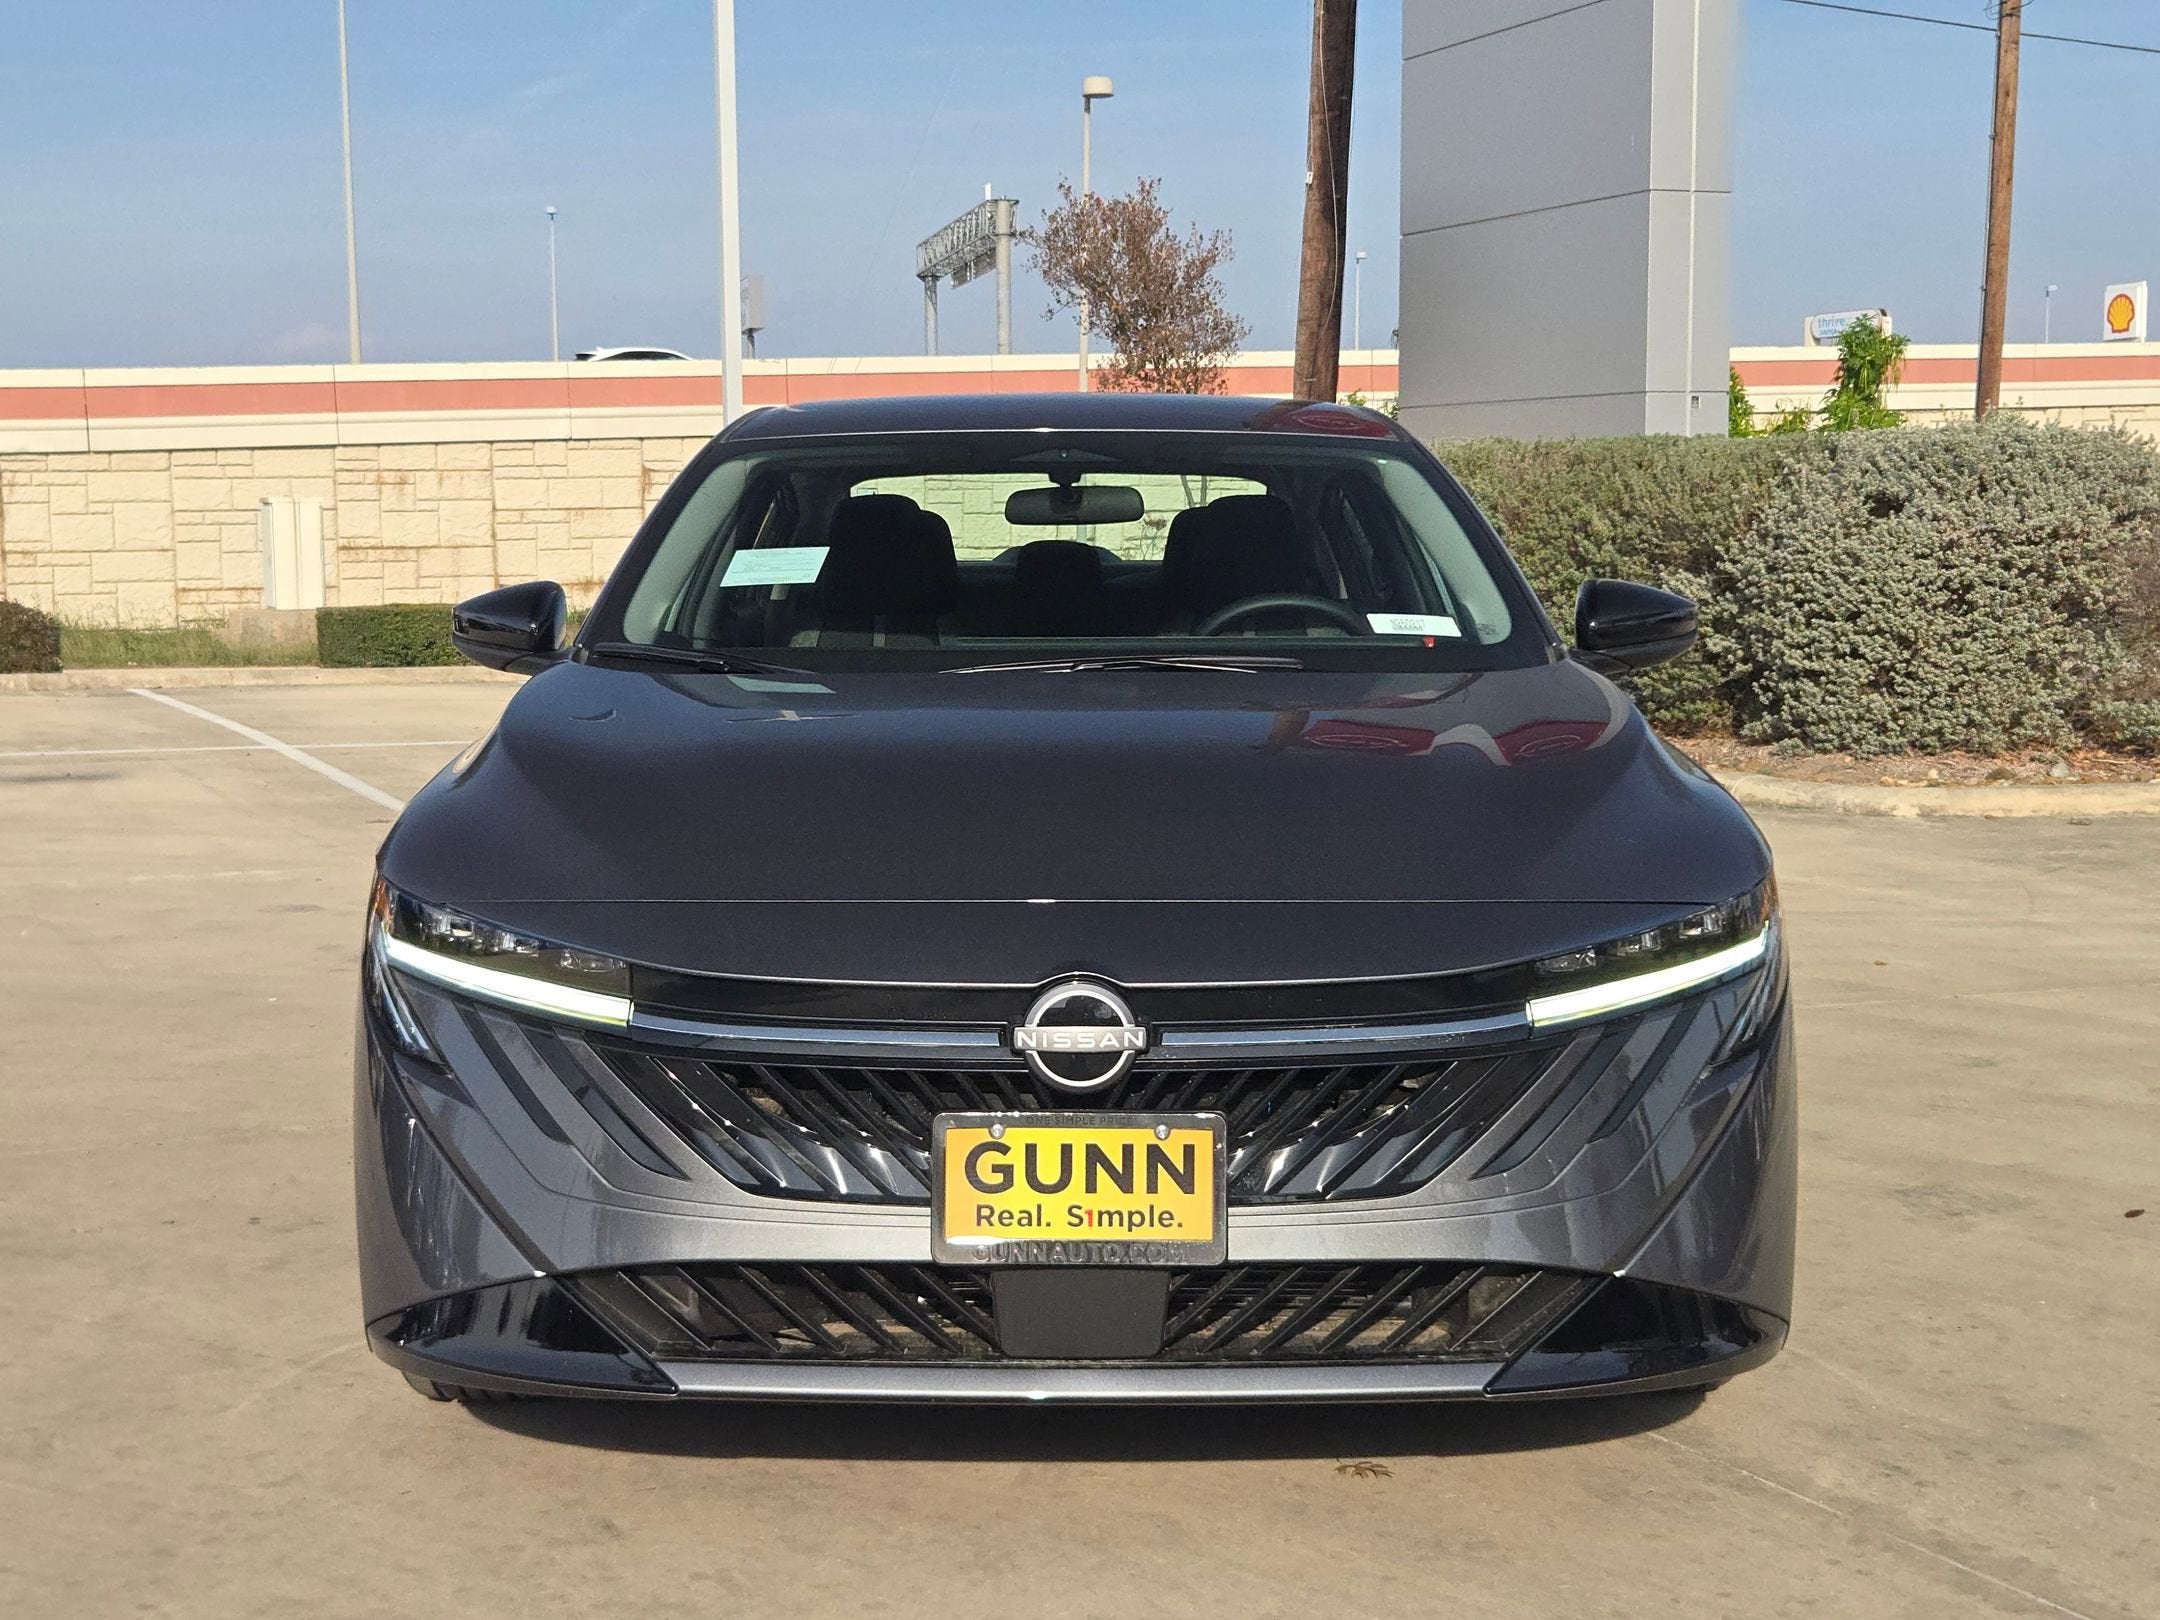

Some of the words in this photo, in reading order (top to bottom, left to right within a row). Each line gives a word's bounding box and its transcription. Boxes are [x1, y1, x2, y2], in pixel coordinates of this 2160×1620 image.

[1818, 317, 1846, 329] thrive
[1017, 1031, 1144, 1048] NISSAN
[1026, 1116, 1051, 1126] ONE
[1054, 1115, 1095, 1126] SIMPLE
[1099, 1116, 1133, 1126] PRICE
[964, 1141, 1196, 1195] GUNN
[976, 1204, 1051, 1227] Real.
[1067, 1204, 1183, 1232] S1mple.
